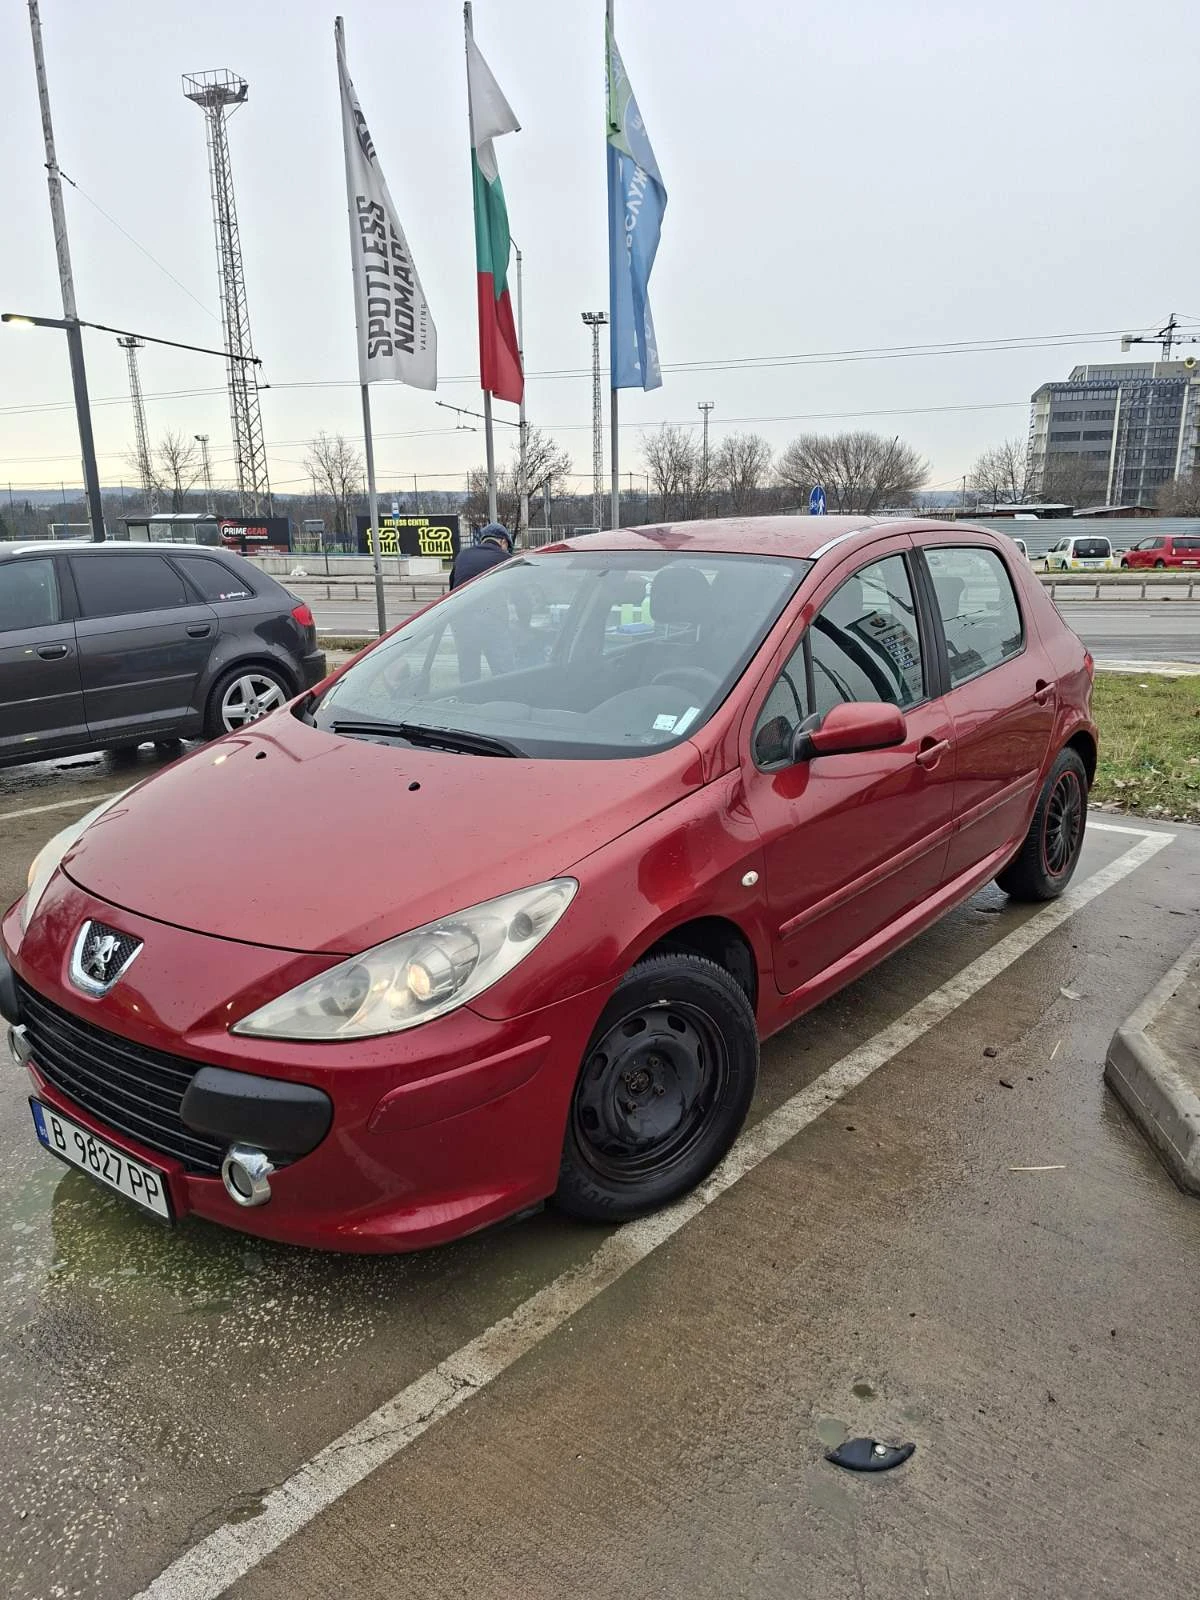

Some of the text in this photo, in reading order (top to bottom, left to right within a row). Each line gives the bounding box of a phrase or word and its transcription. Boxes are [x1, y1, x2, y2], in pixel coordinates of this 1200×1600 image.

[355, 195, 394, 360] SPOTLESS
[407, 518, 430, 527] CENTER
[51, 1116, 159, 1204] B 9827 PP
